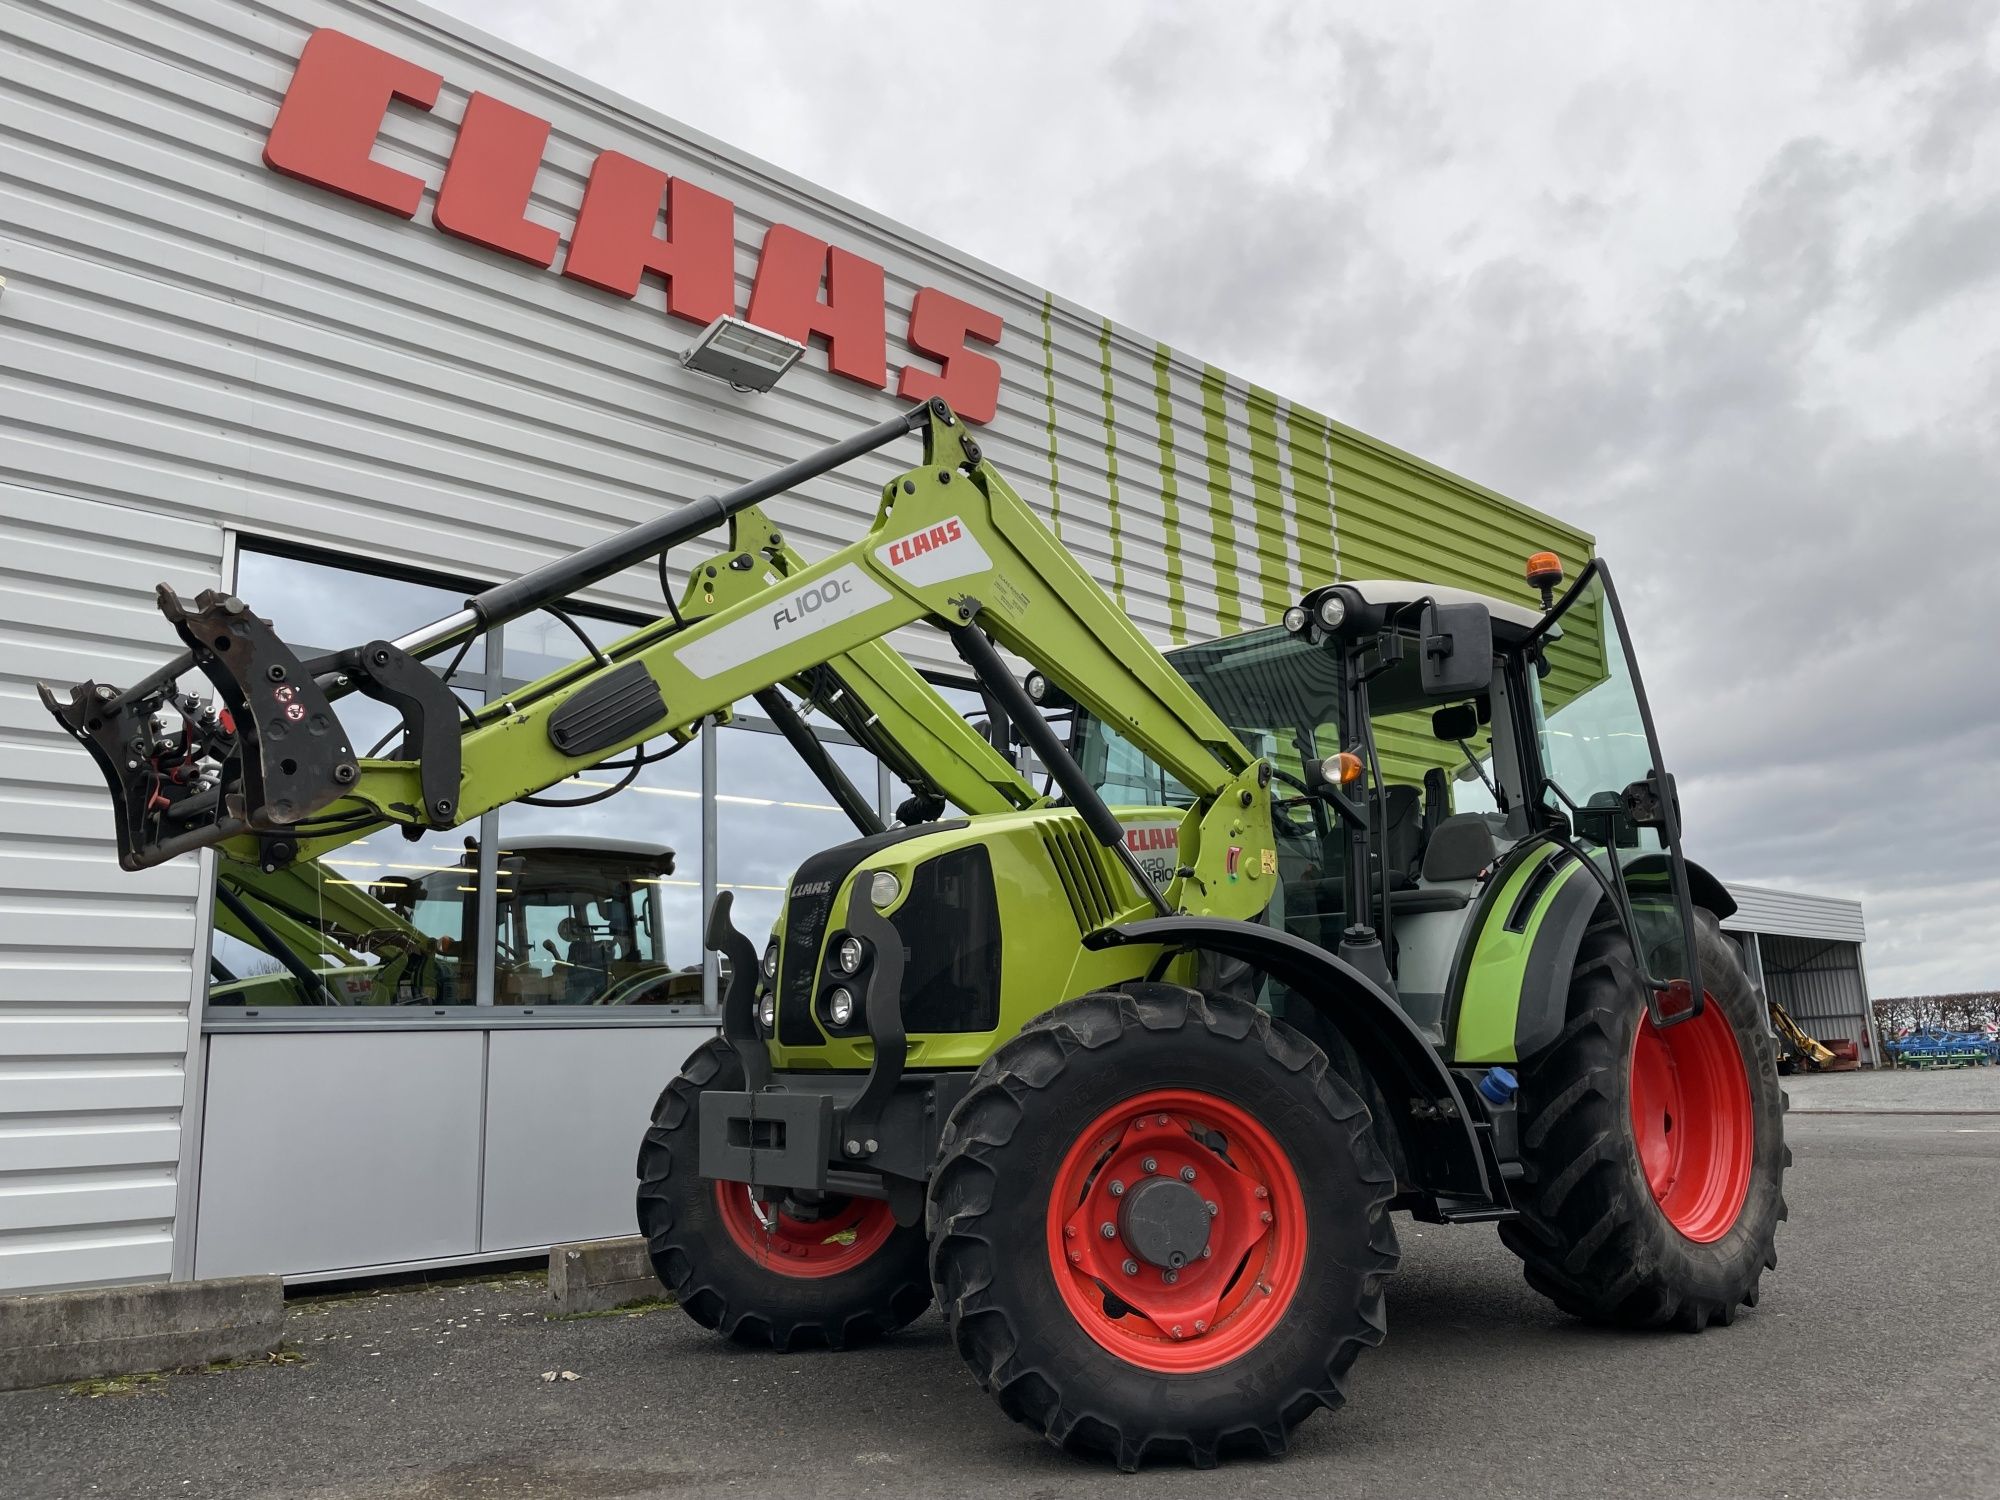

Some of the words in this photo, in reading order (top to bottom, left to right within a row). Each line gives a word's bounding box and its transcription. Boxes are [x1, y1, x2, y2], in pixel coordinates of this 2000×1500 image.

[262, 27, 1004, 425] CLAAS
[889, 520, 962, 567] CLAAS
[1127, 827, 1178, 852] CLAA
[1147, 866, 1177, 884] RIO
[791, 880, 831, 898] CLAAS
